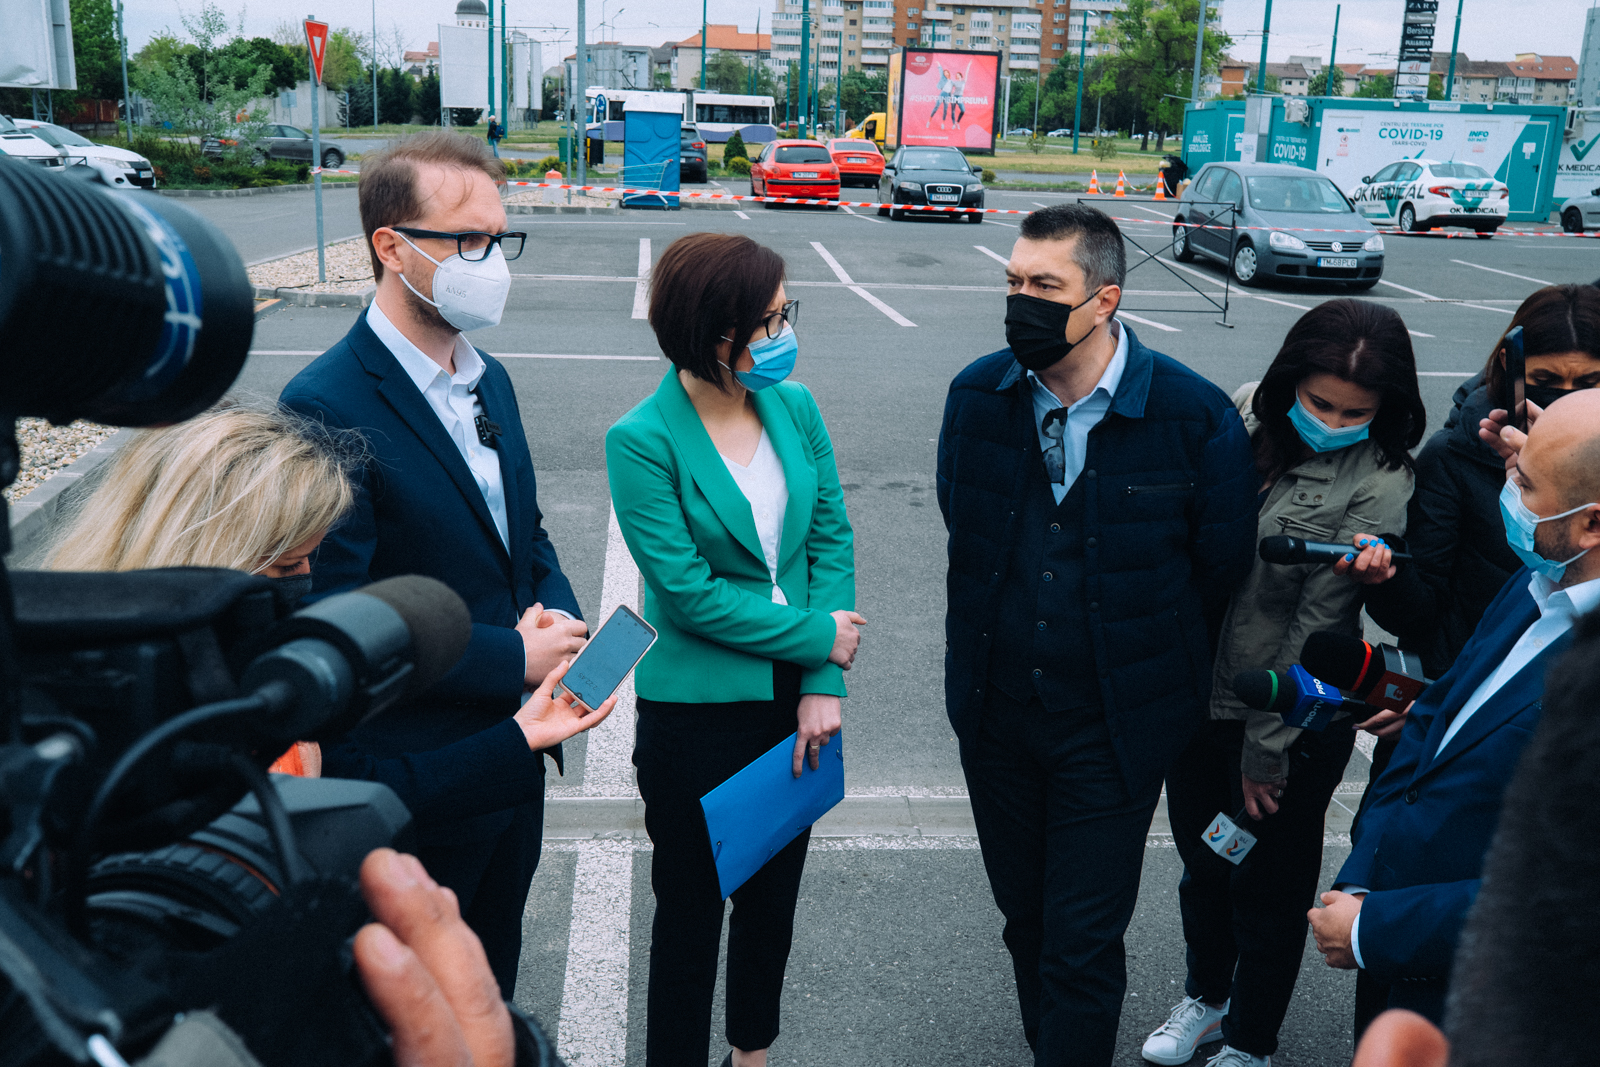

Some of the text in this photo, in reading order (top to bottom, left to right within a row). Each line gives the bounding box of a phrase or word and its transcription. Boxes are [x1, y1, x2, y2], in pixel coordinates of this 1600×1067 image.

[1406, 26, 1433, 35] Bershka
[1378, 127, 1444, 141] COVID-19
[1469, 130, 1489, 138] INFO
[1273, 142, 1307, 161] COVID-19
[1353, 183, 1425, 201] OK MEDICAL
[445, 284, 467, 299] KN95
